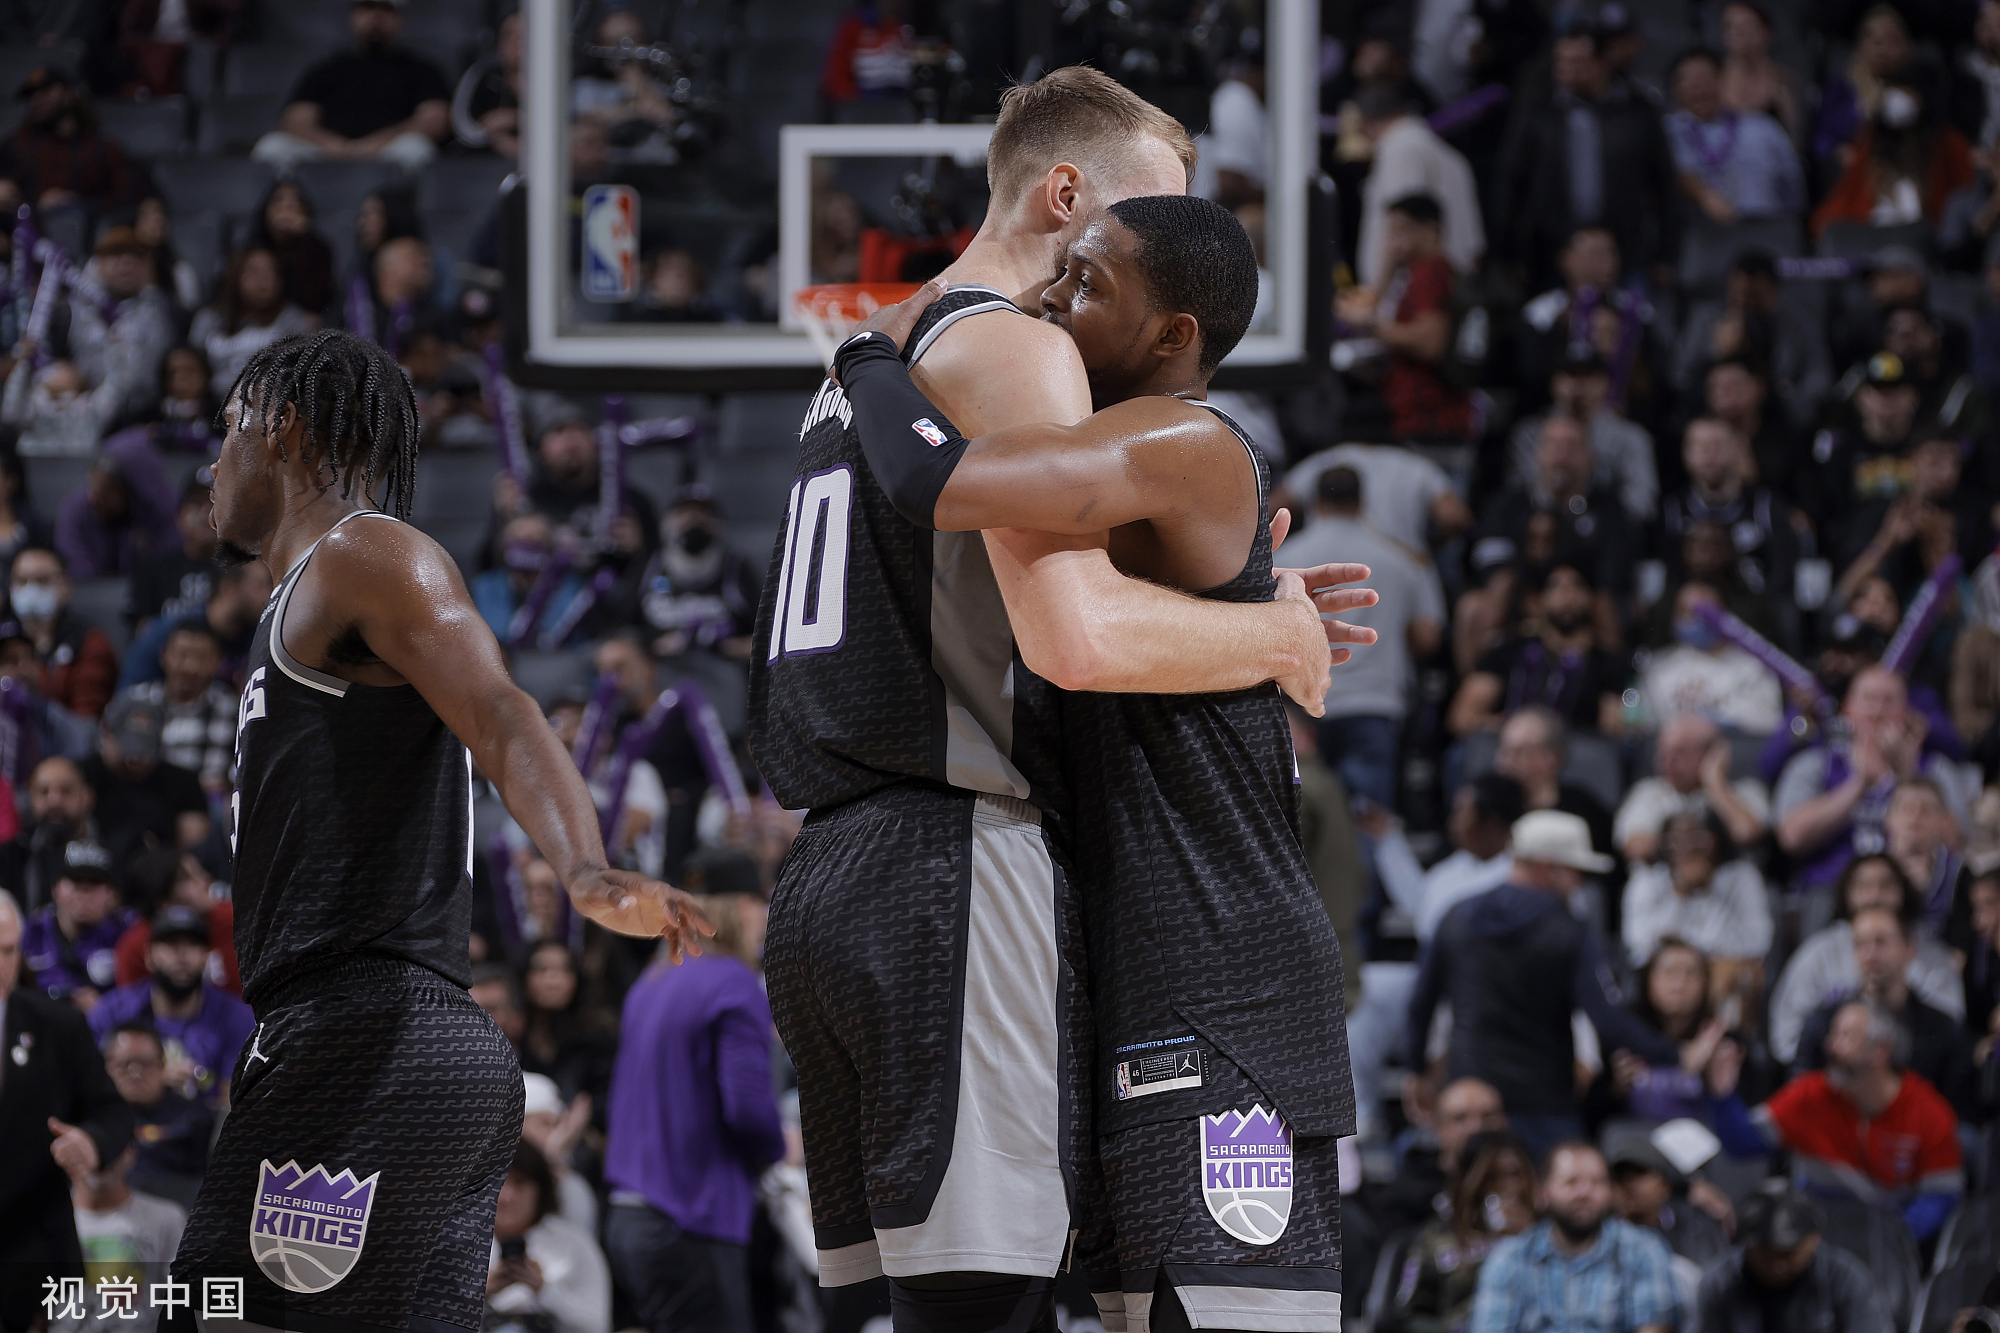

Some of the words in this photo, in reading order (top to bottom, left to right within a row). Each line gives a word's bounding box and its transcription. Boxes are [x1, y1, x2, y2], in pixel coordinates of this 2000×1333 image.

[767, 463, 854, 665] 10
[1164, 1034, 1196, 1046] PROUD
[1209, 1144, 1290, 1156] SACRAMENTO
[1206, 1161, 1292, 1189] KINGS
[262, 1193, 363, 1218] SACRAMENTO
[254, 1208, 363, 1248] KINGS
